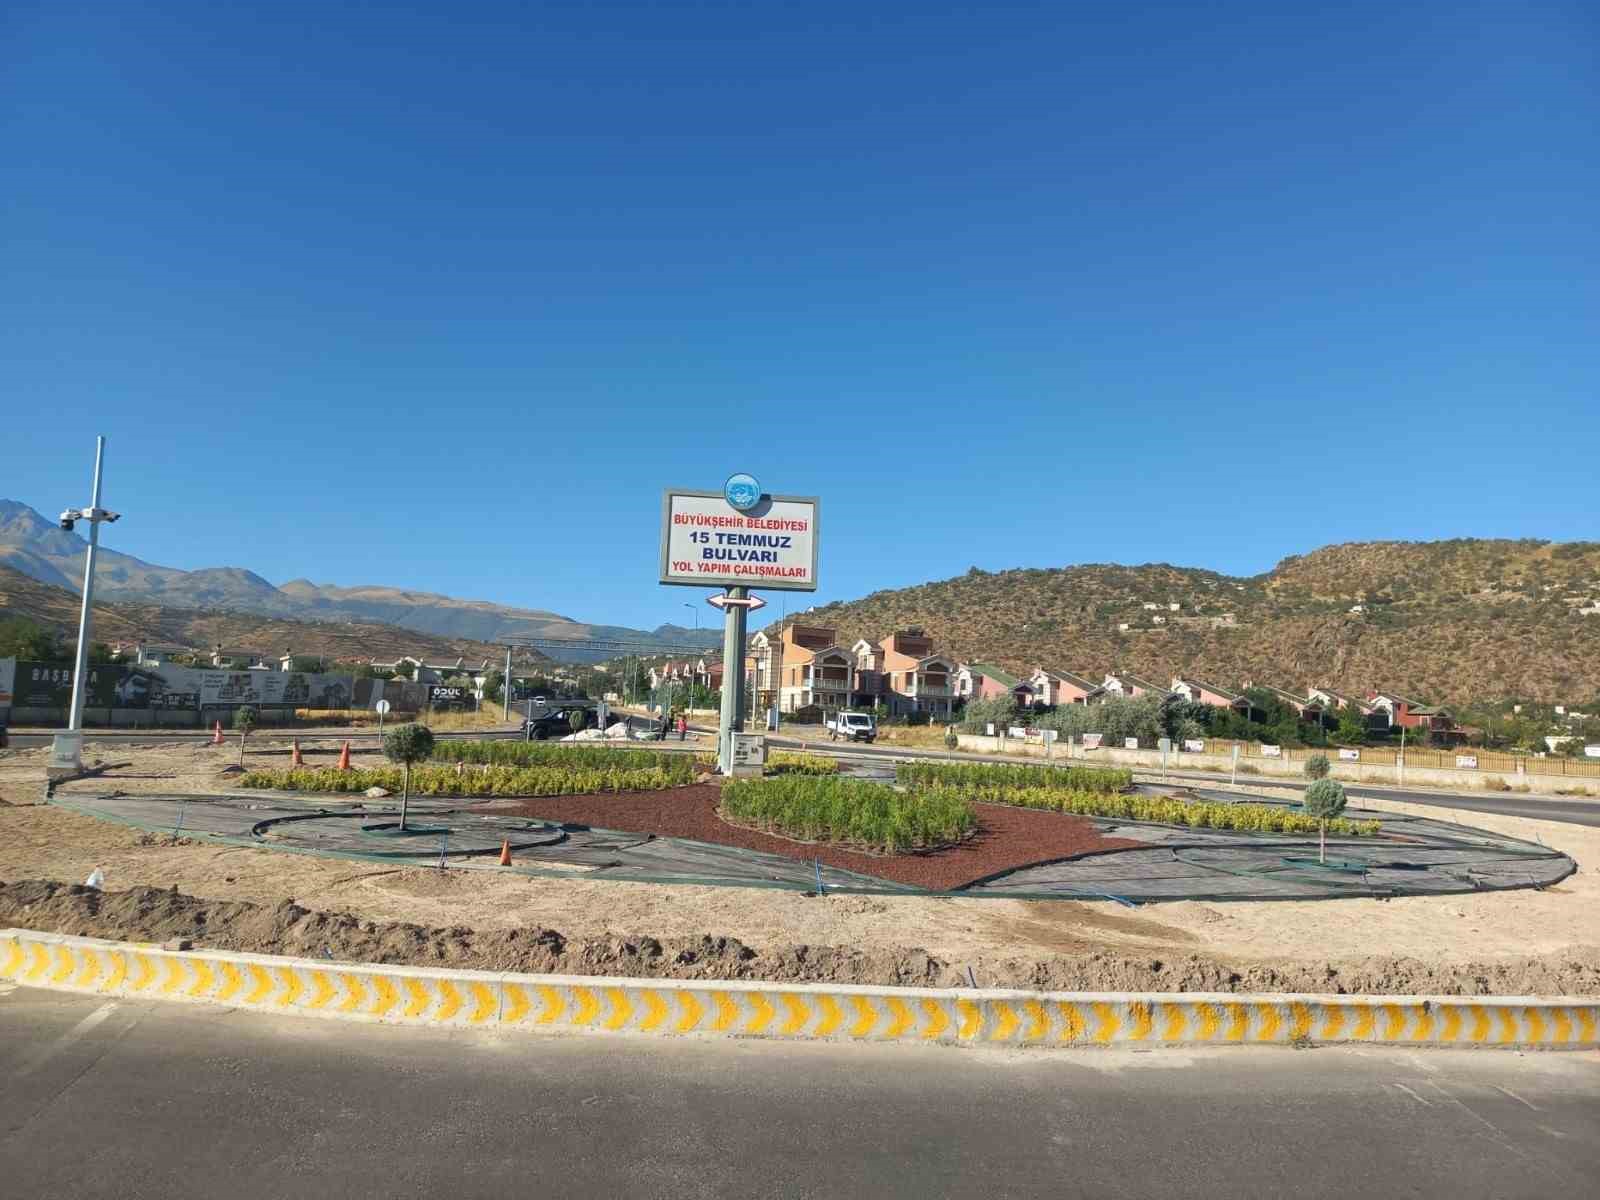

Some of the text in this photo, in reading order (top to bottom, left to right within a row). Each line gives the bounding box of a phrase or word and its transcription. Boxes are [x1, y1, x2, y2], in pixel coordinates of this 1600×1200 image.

[674, 513, 808, 531] BÜYÜKŞEHİR BELEDİYESİ
[689, 531, 792, 548] 15 TEMMUZ
[702, 547, 778, 562] BULVARI
[672, 561, 693, 572] YOL
[697, 563, 731, 574] YAPIM
